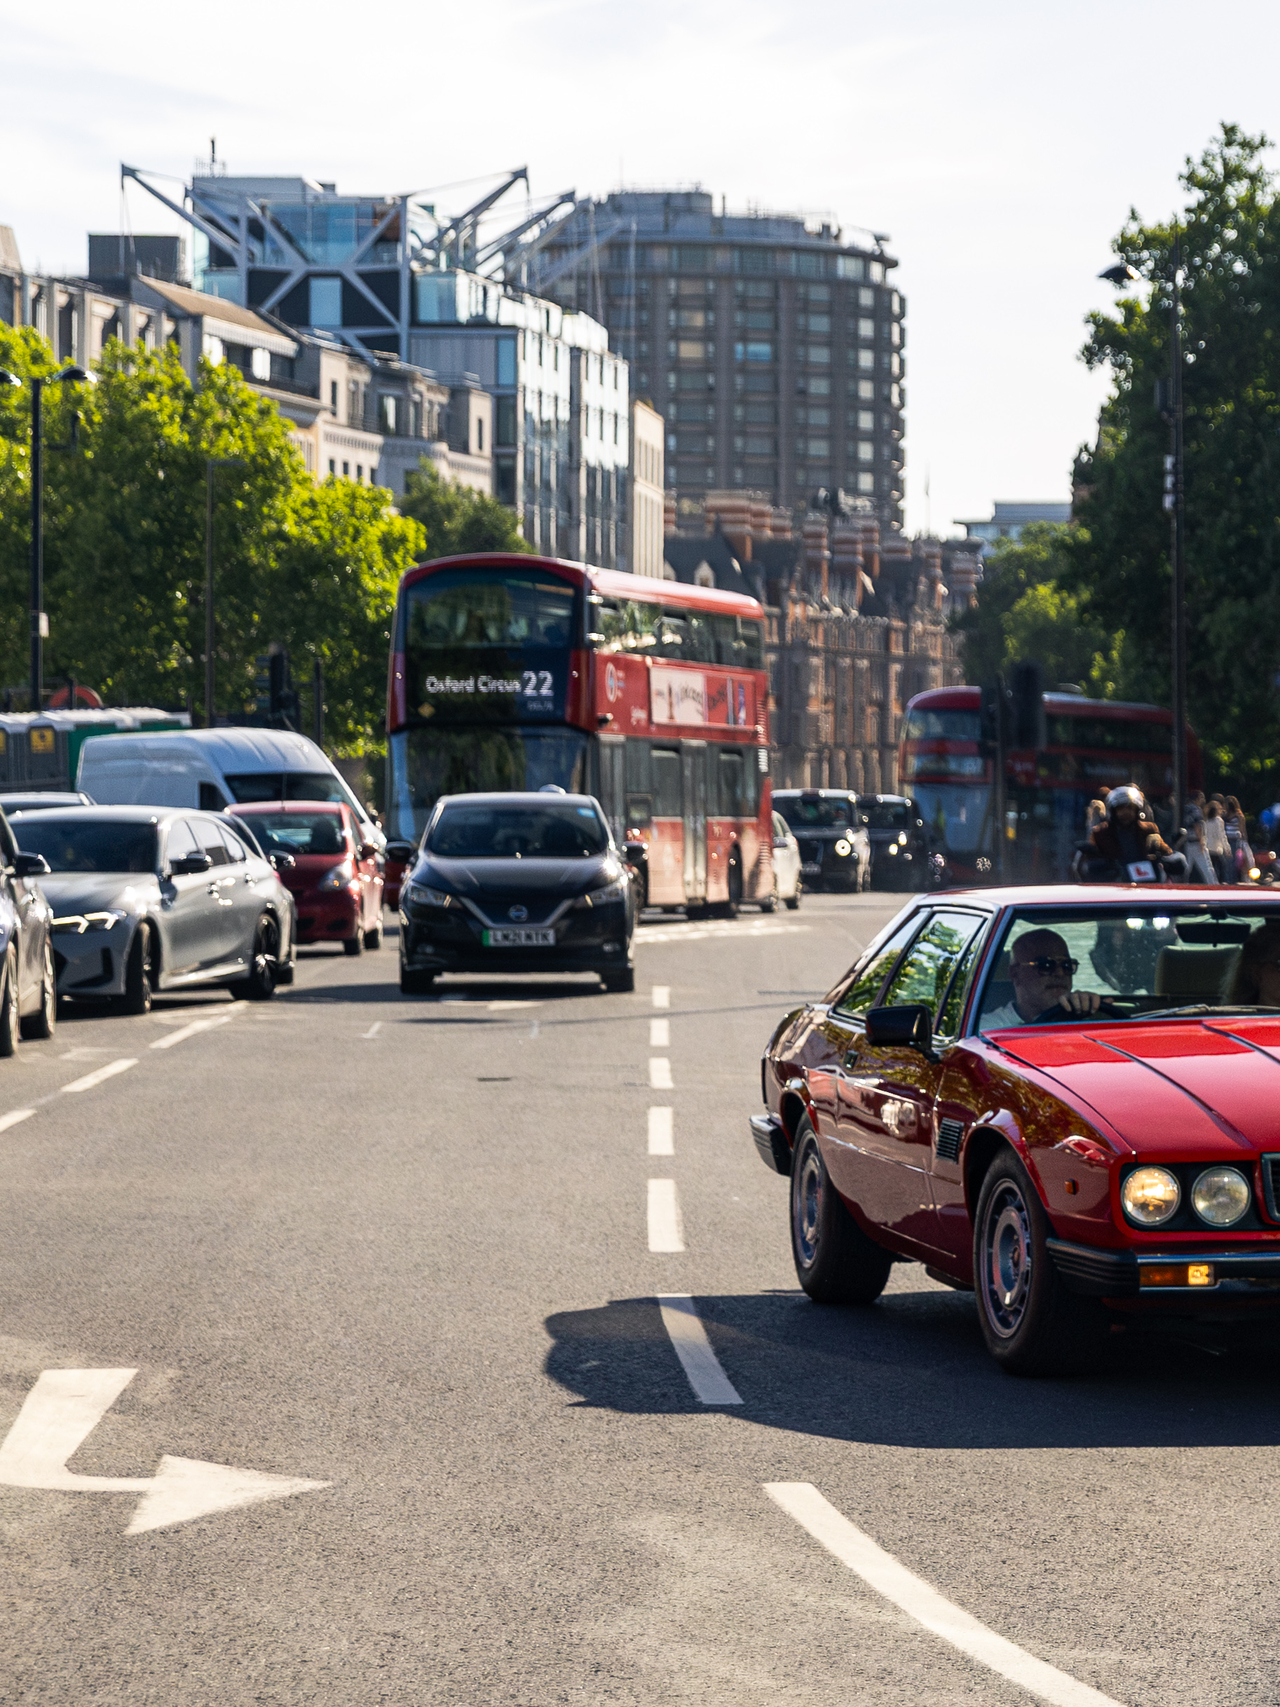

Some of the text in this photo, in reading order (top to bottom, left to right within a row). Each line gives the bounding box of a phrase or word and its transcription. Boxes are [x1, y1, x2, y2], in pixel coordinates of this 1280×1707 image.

[426, 670, 554, 697] Oxford Circus 22
